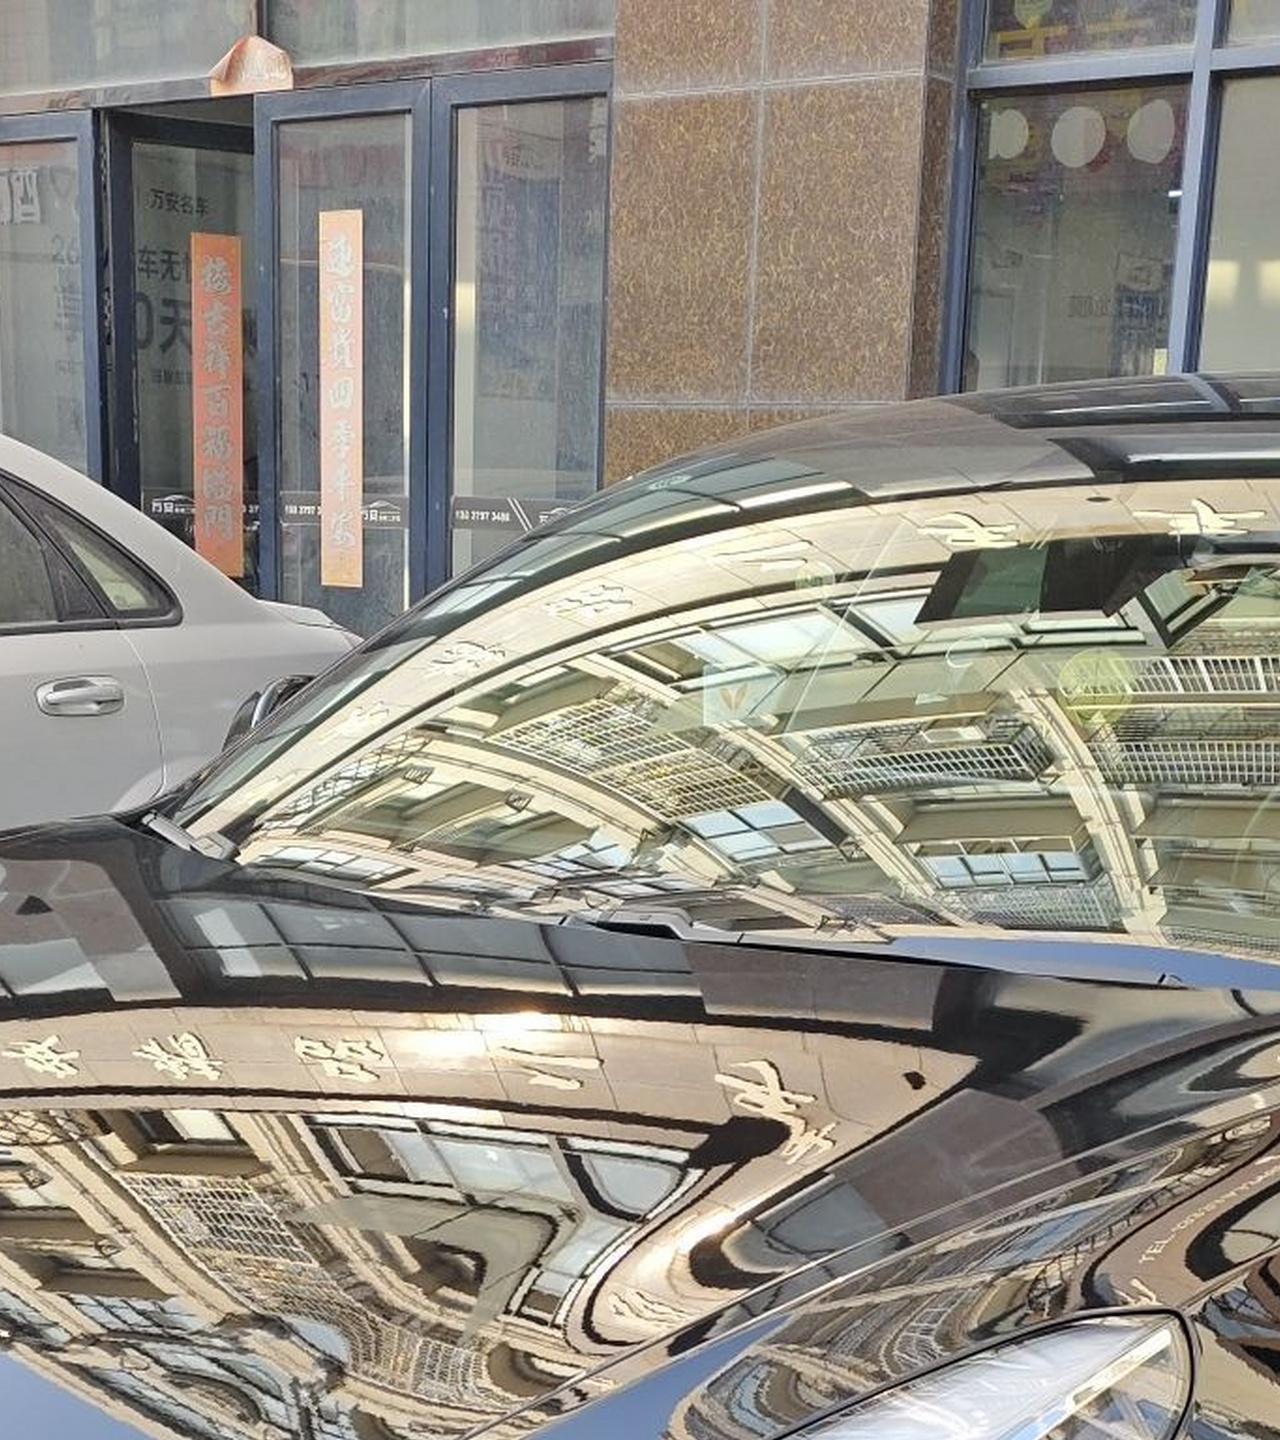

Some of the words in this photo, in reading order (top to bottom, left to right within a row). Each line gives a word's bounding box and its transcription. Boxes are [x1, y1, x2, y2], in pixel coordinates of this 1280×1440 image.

[148, 188, 210, 217] 万安名车
[137, 244, 192, 284] 车无
